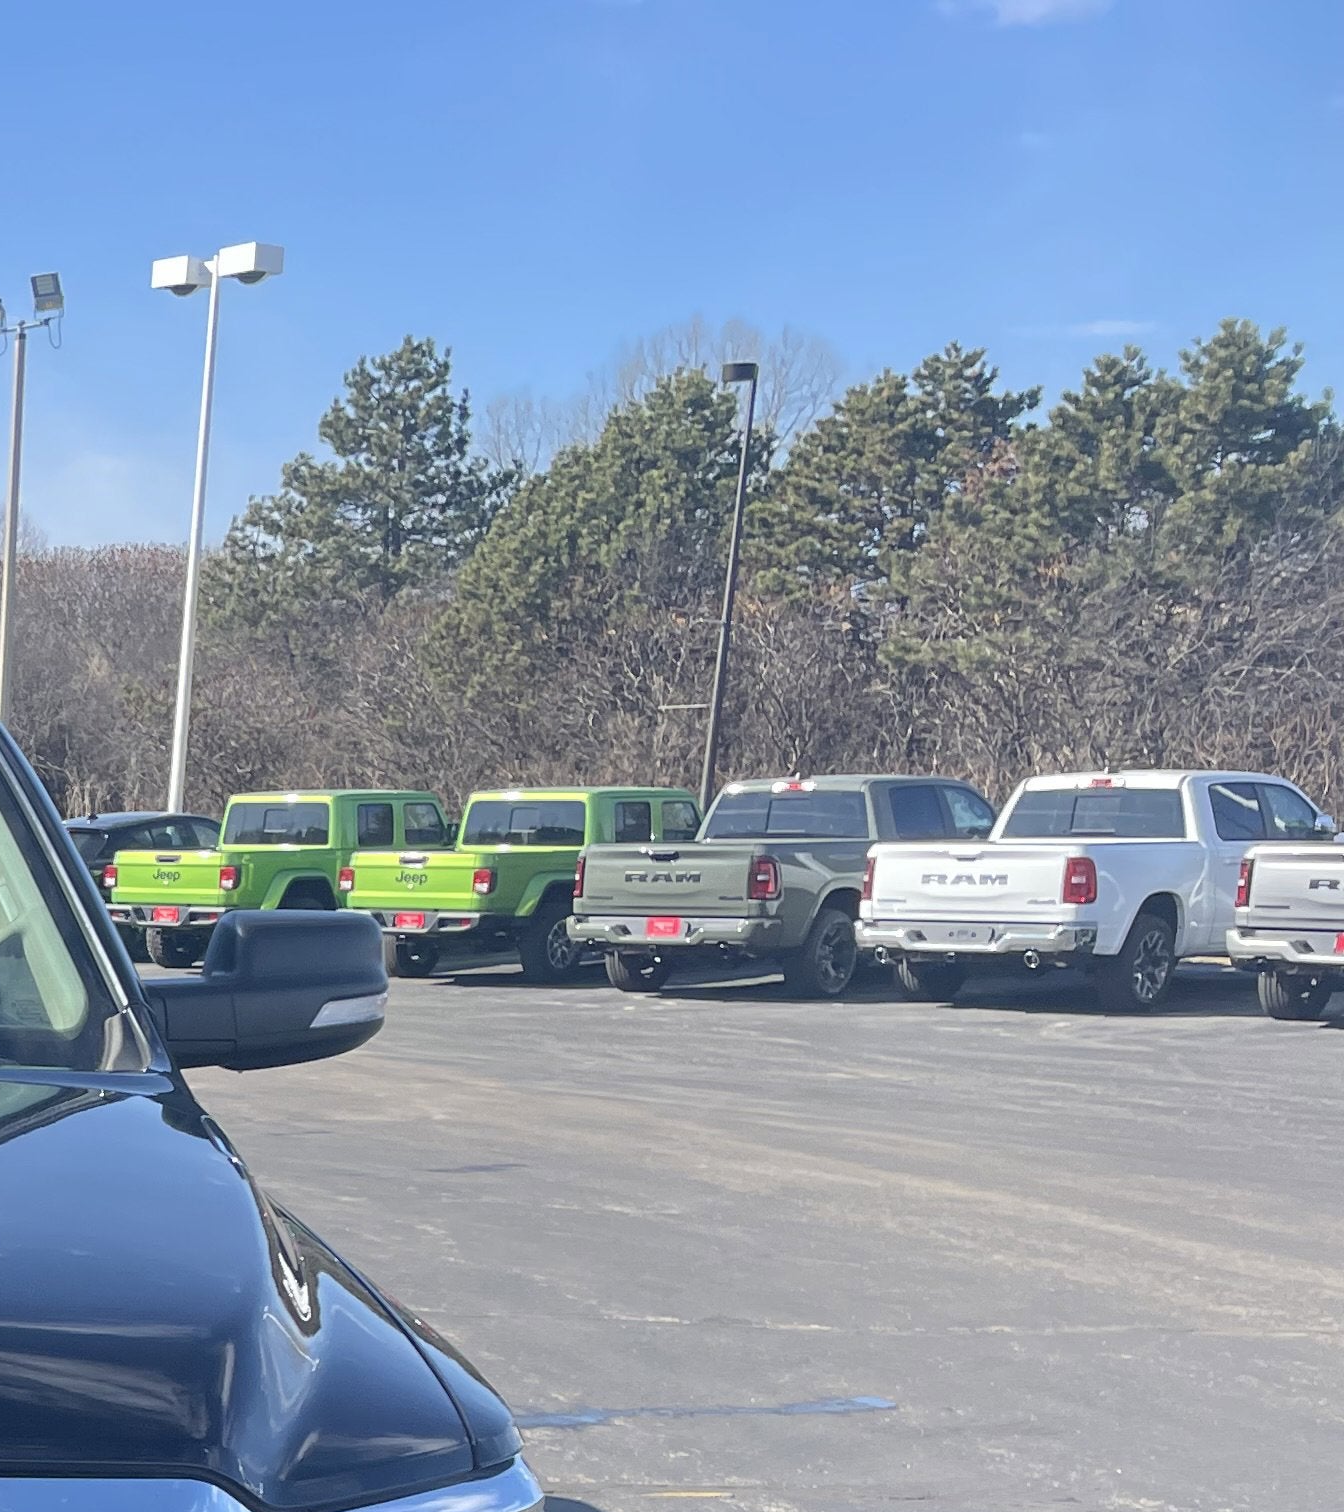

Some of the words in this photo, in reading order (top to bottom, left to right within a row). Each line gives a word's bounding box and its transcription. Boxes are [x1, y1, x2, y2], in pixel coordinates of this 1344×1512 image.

[152, 868, 181, 882] Jeep
[395, 870, 428, 885] Jeep
[624, 870, 702, 883] RAM
[921, 873, 1009, 886] RAM
